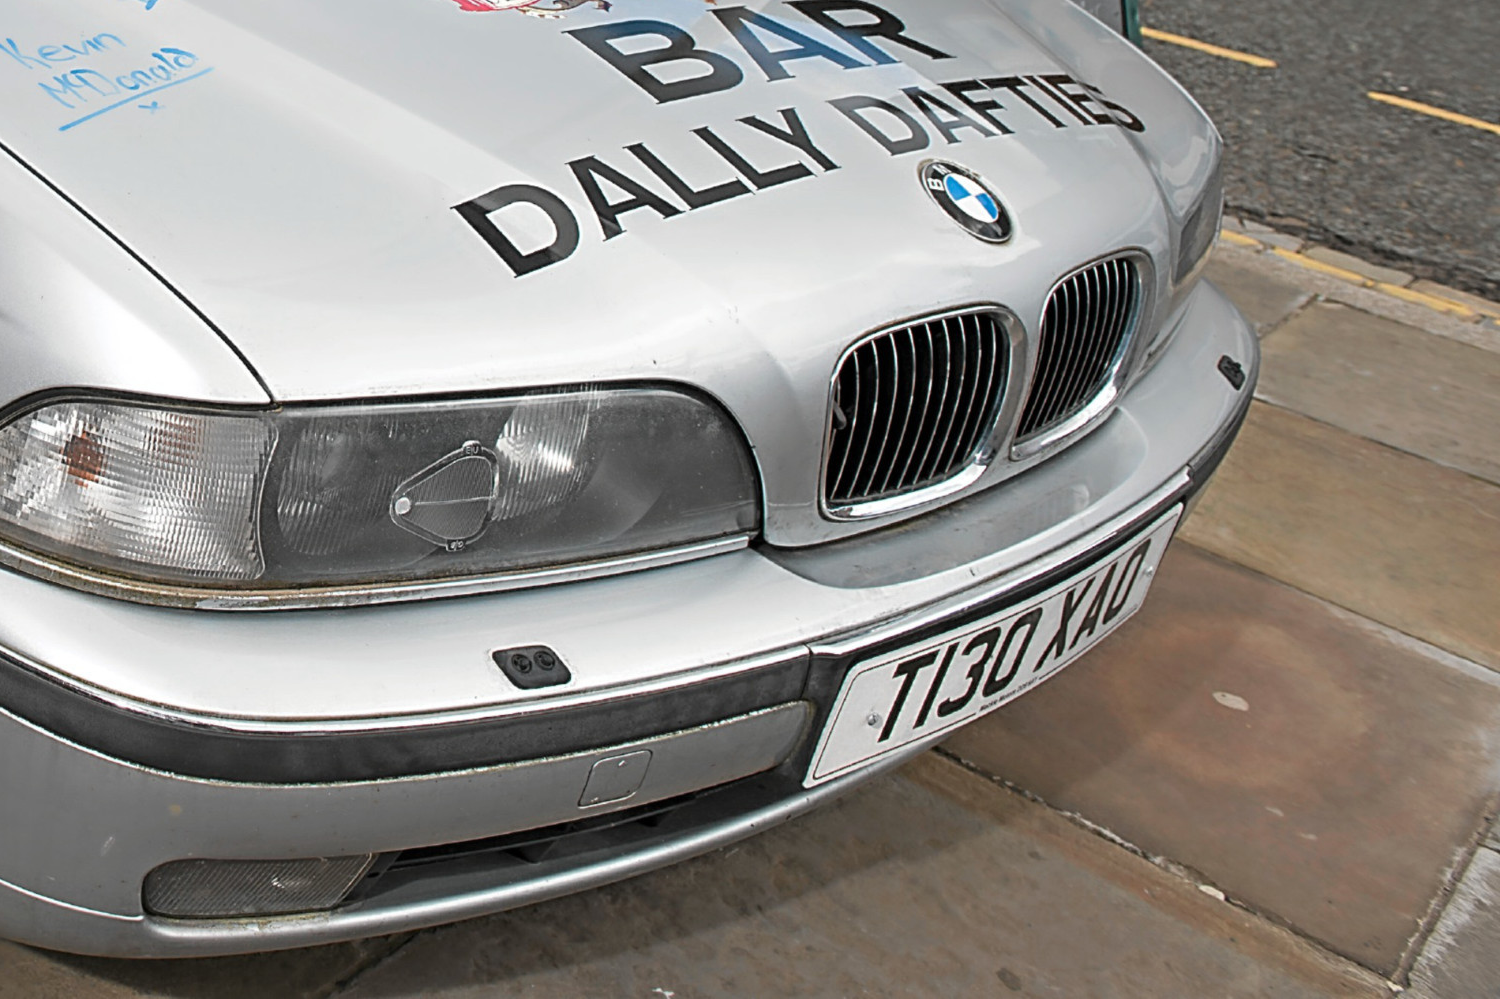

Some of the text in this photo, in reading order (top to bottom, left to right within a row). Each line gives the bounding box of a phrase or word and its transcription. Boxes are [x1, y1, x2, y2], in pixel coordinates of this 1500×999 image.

[450, 74, 1146, 279] DALLY DAFTIES
[877, 605, 1044, 744] T130
